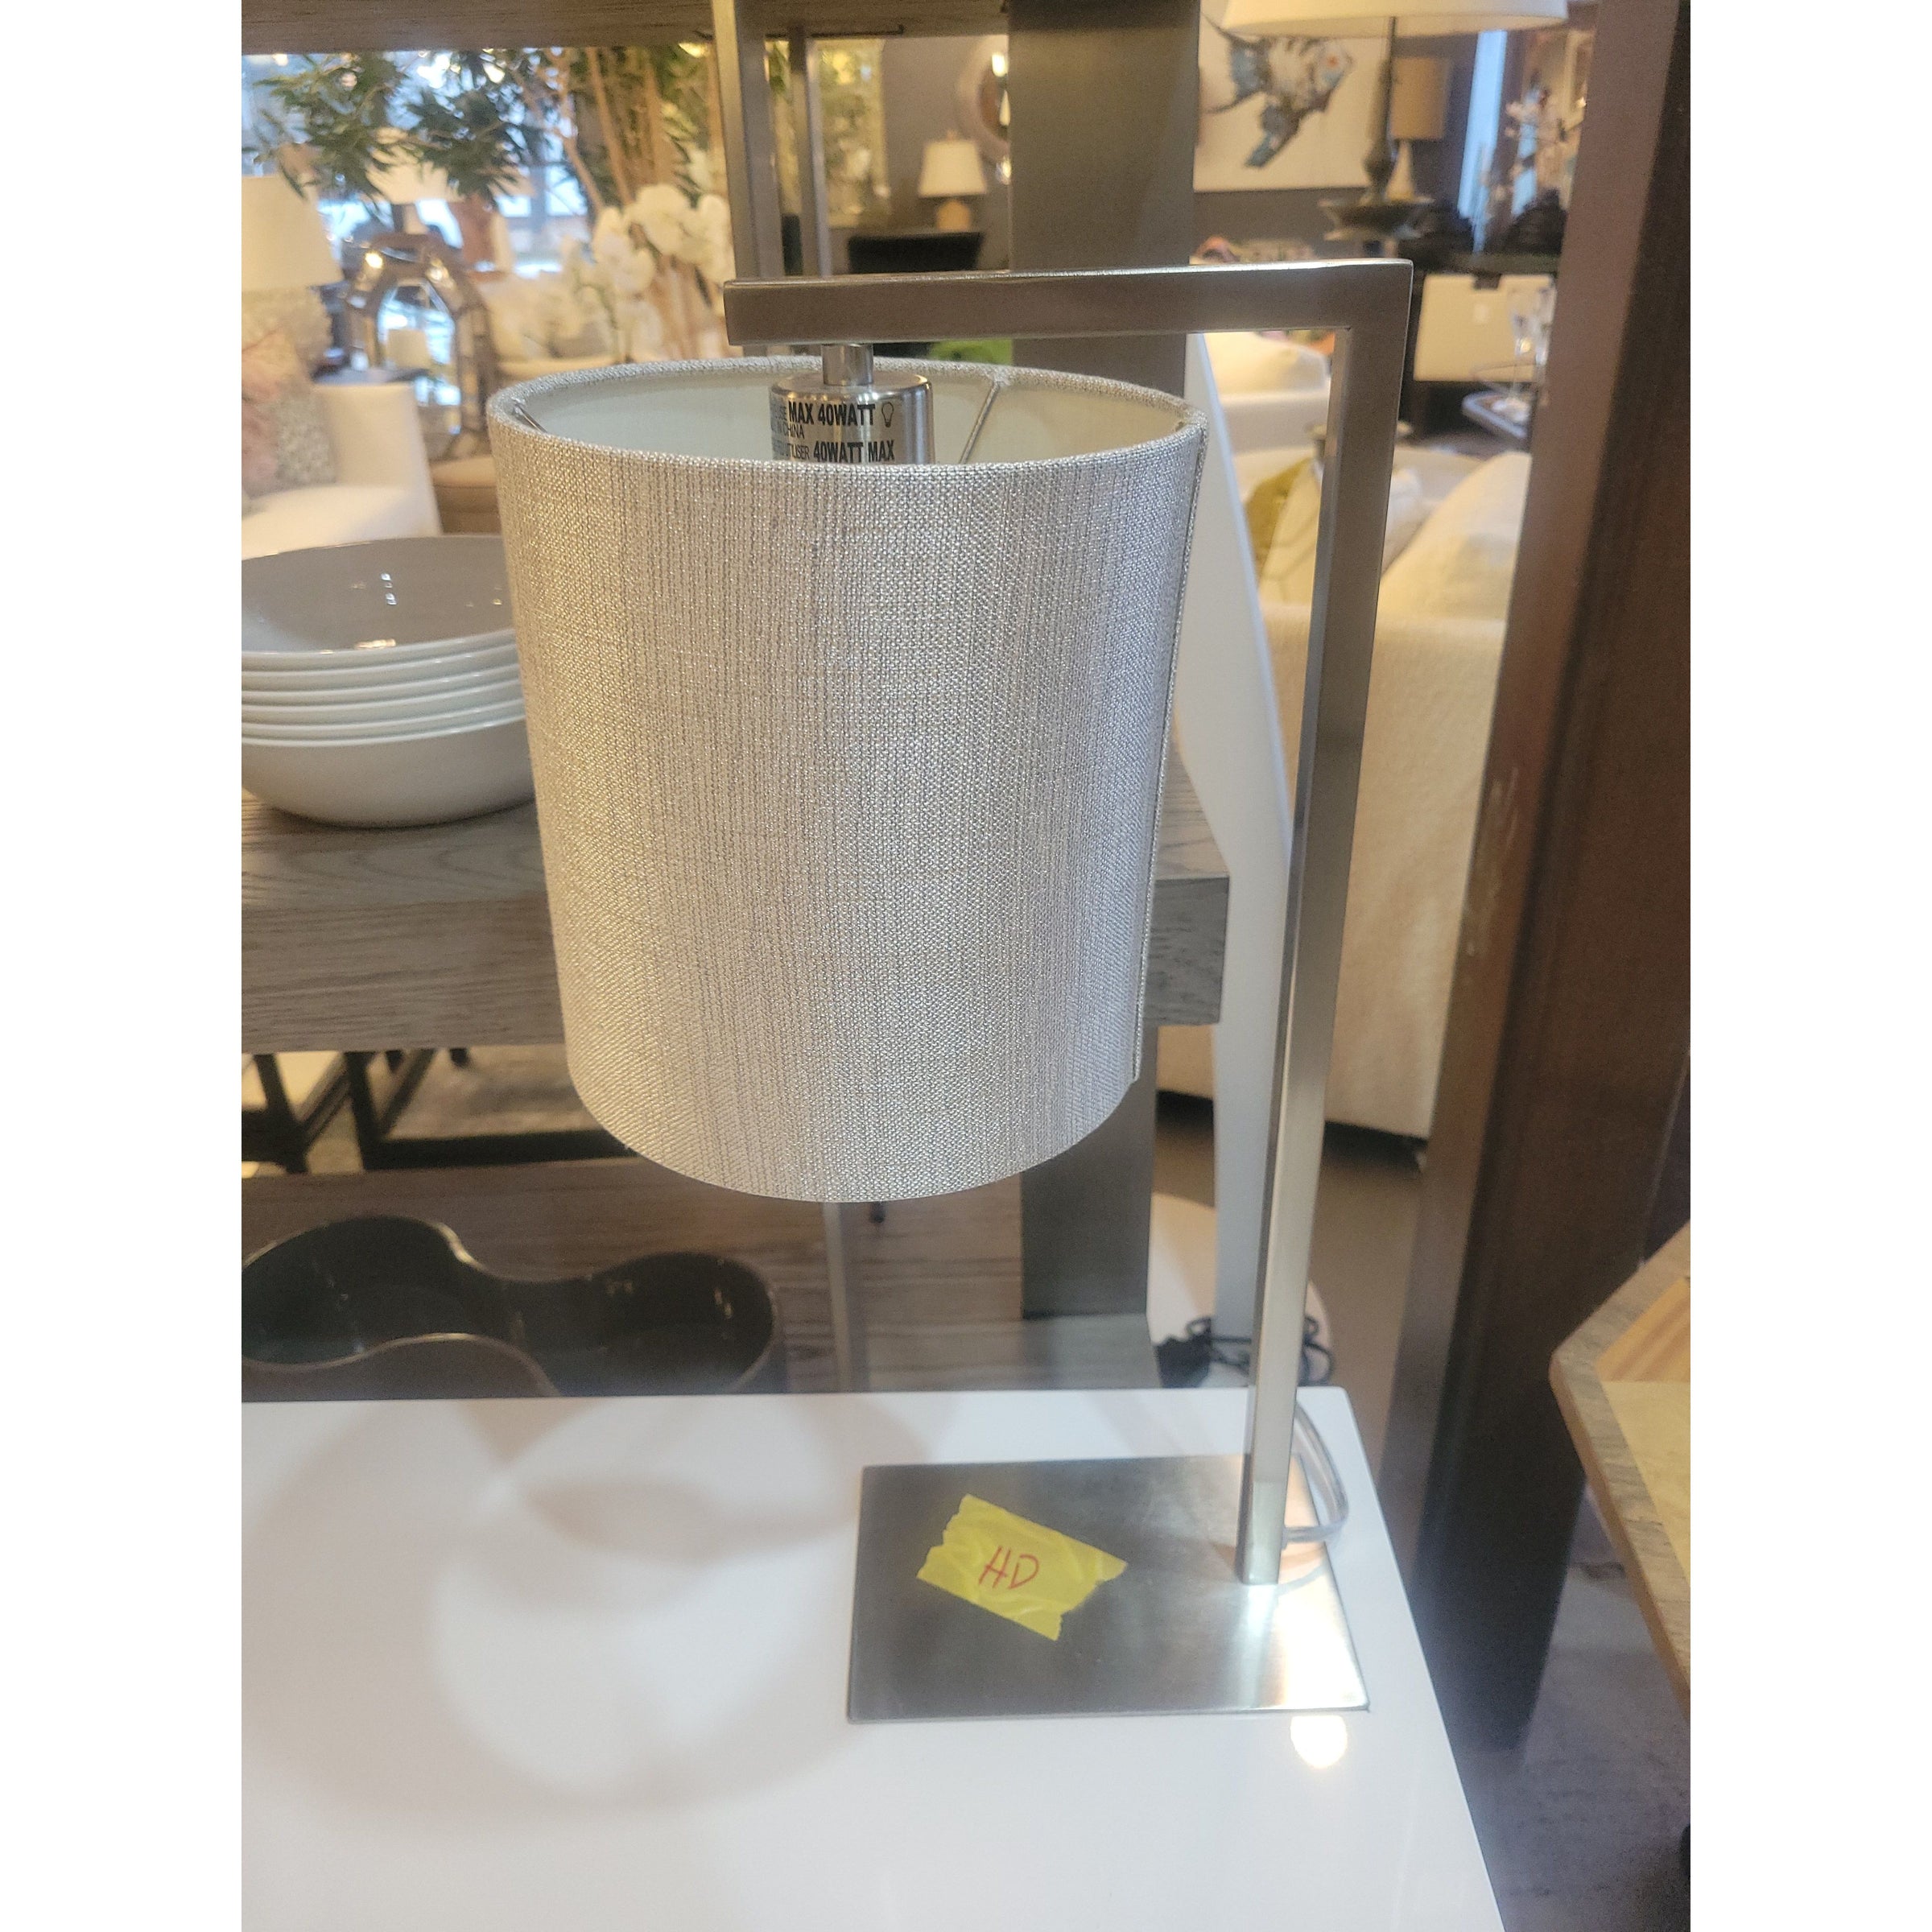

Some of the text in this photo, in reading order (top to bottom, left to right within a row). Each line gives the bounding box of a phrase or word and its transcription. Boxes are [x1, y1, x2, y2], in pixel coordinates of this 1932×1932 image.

[789, 400, 814, 425] MAX
[818, 403, 875, 426] 40WATT
[783, 421, 804, 439] CHINA
[814, 440, 863, 463] 40WATT
[868, 440, 895, 462] MAX
[978, 1545, 1039, 1590] HD
